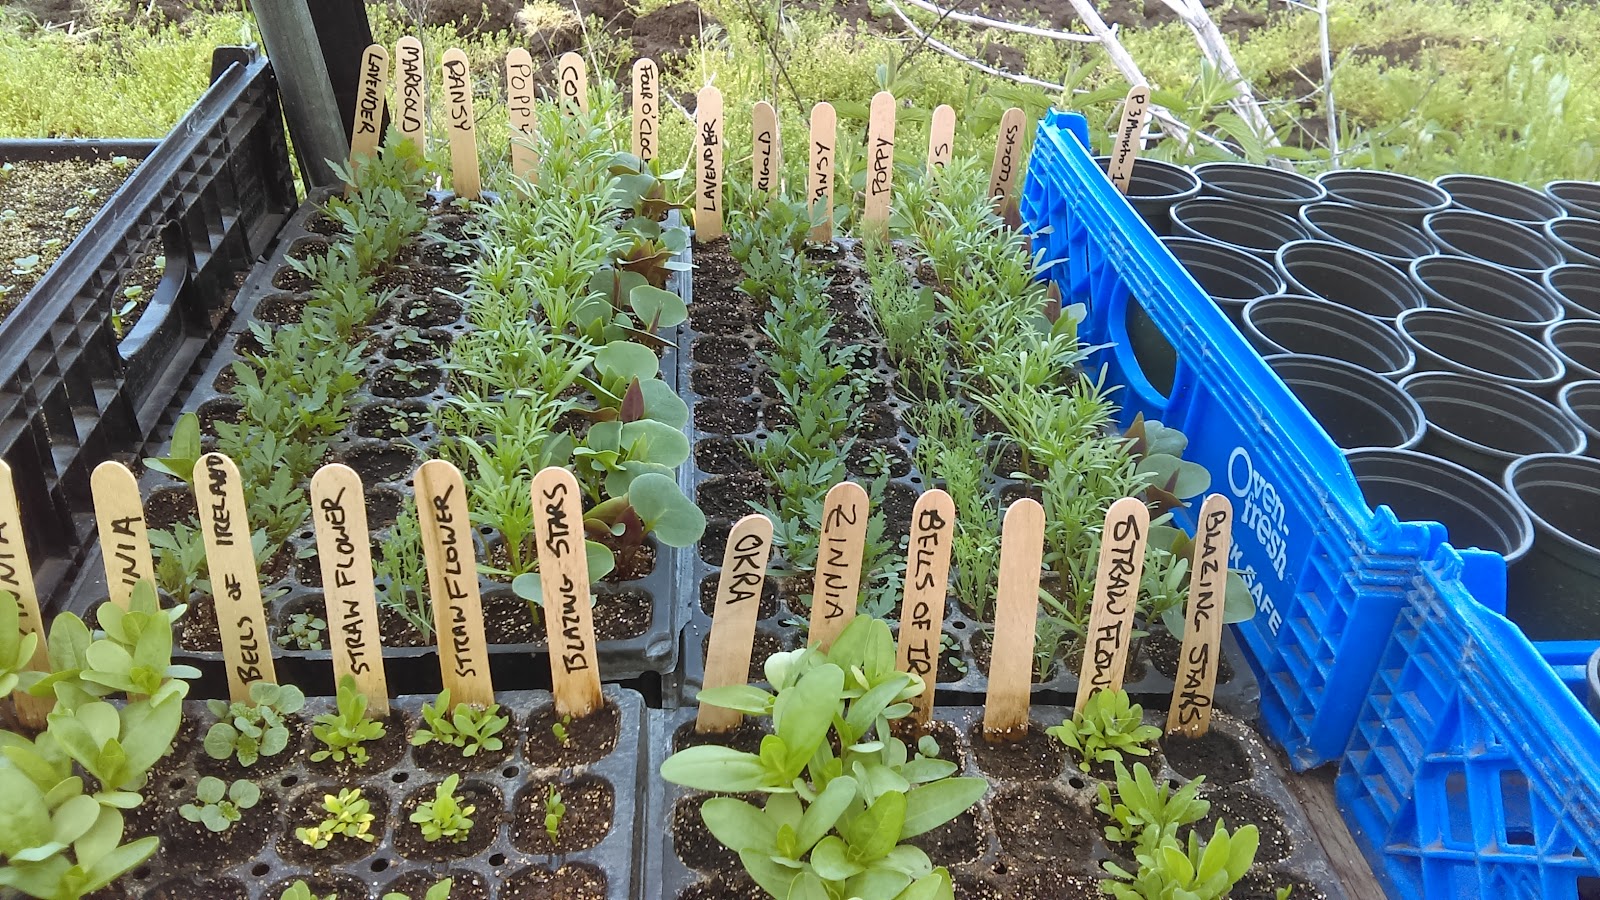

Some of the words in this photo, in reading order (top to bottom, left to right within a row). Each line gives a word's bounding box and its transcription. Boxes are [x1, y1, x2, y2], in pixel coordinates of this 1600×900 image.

[357, 53, 383, 134] LAVENDER
[402, 46, 421, 133] MARIGOLD
[443, 60, 471, 131] PANSY
[640, 103, 657, 165] O'CLOC
[703, 119, 717, 213] LAVENDER
[757, 131, 772, 194] RIGOLD
[871, 137, 894, 197] POPPY
[205, 455, 234, 547] IRELAND
[320, 486, 355, 589] FLOWER
[543, 483, 570, 558] STARS
[1241, 493, 1288, 582] fresh
[433, 484, 469, 600] FLOWER
[725, 534, 764, 605] OKRA
[823, 503, 857, 619] ZINNIA
[914, 508, 946, 591] BELLS
[1106, 514, 1141, 617] STRAW
[1193, 510, 1227, 634] BLAZING
[236, 616, 264, 686] BELLS
[341, 600, 371, 676] STRAW
[449, 606, 477, 678] STRAW
[559, 573, 589, 675] BLAZING
[912, 602, 931, 631] OF
[1088, 618, 1126, 699] FLOW
